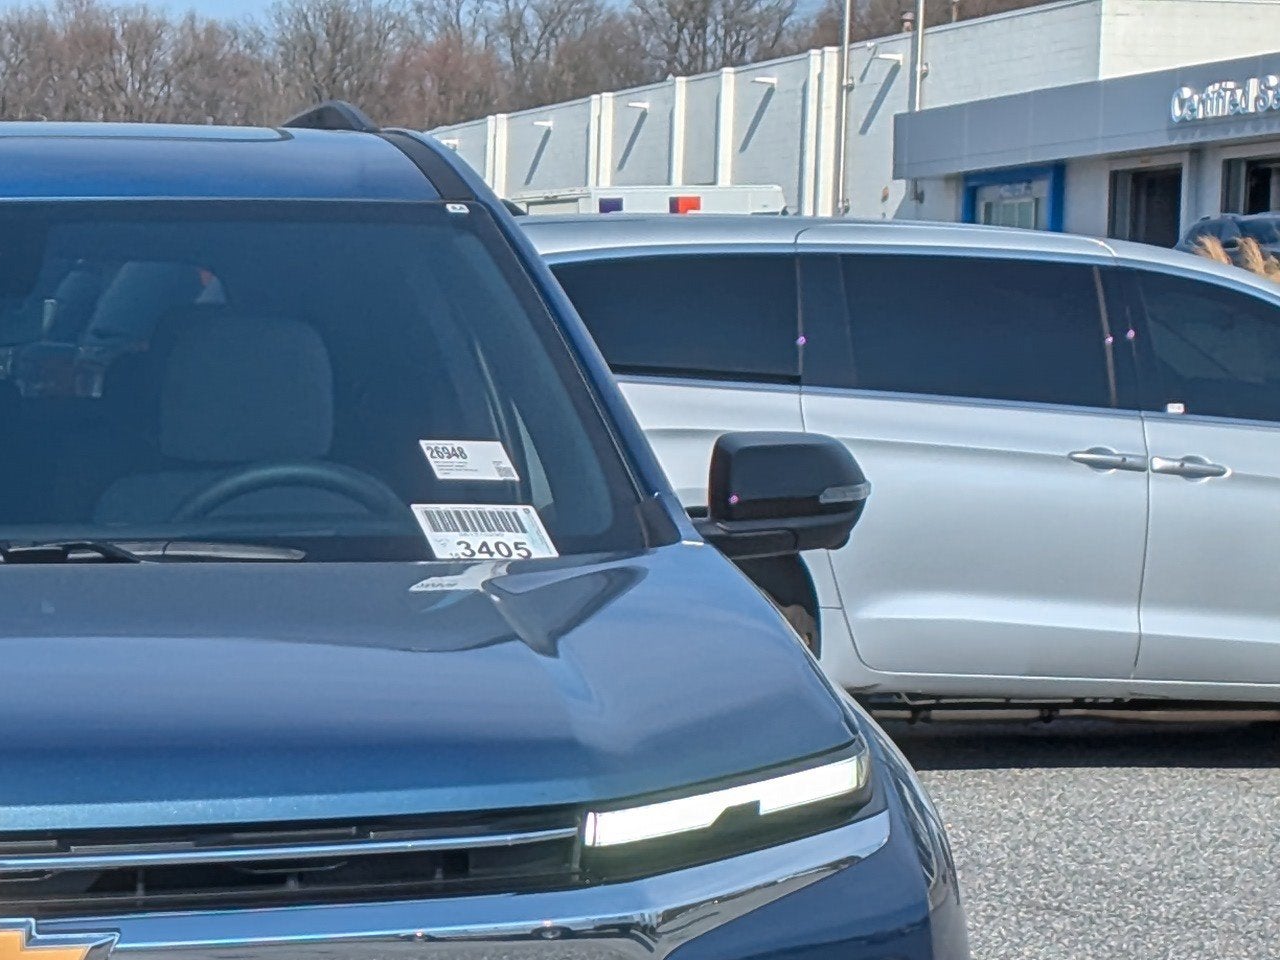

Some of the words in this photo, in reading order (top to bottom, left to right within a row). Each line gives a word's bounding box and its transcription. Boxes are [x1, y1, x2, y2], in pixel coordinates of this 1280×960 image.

[1171, 77, 1259, 123] Certified
[426, 445, 468, 460] 26948
[456, 540, 533, 560] 3405
